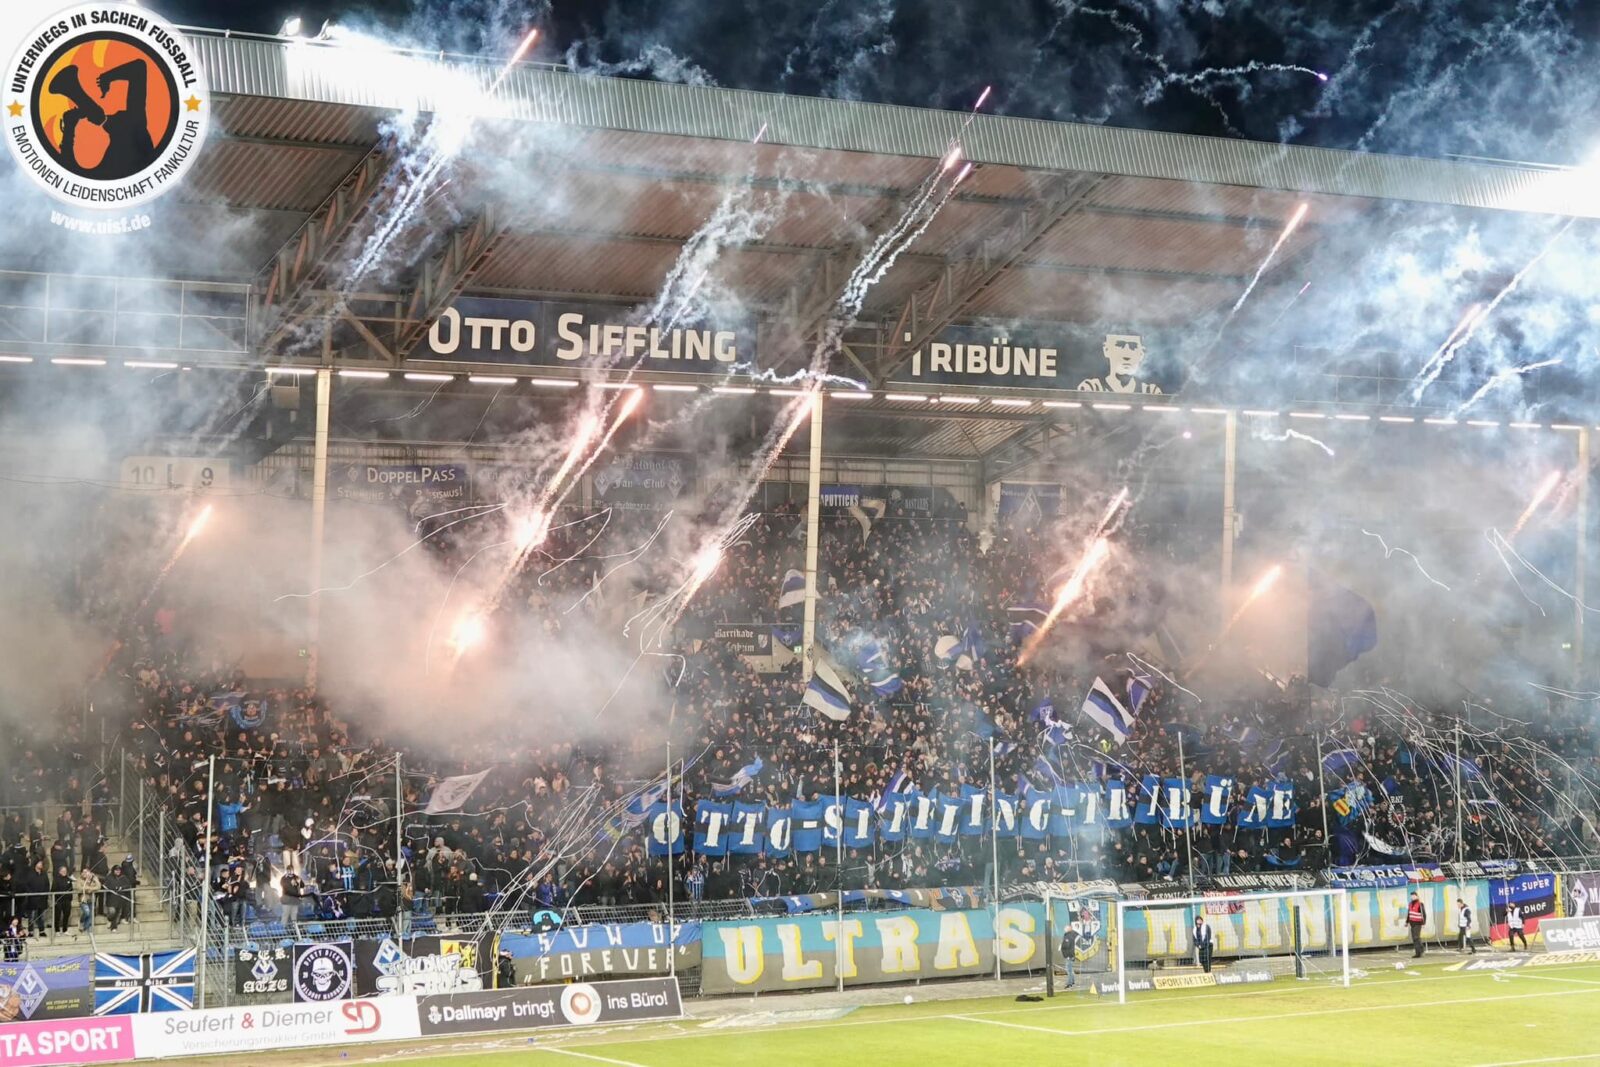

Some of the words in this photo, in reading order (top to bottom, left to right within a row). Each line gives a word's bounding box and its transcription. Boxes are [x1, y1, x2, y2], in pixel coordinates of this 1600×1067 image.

[428, 306, 535, 355] OTTO
[556, 312, 736, 362] SIFFLING
[201, 467, 214, 487] 9
[718, 908, 1037, 985] ULTRAS
[1128, 974, 1150, 990] bwin
[1156, 973, 1215, 987] SPORTWETTEN
[443, 1003, 507, 1023] Dallmayr
[513, 1000, 555, 1019] bringt
[608, 993, 627, 1009] ins
[631, 991, 668, 1008] Büro!
[164, 1012, 234, 1035] Seufert
[240, 1011, 254, 1029] &
[262, 1010, 333, 1029] Diemer
[37, 1026, 122, 1054] SPORT
